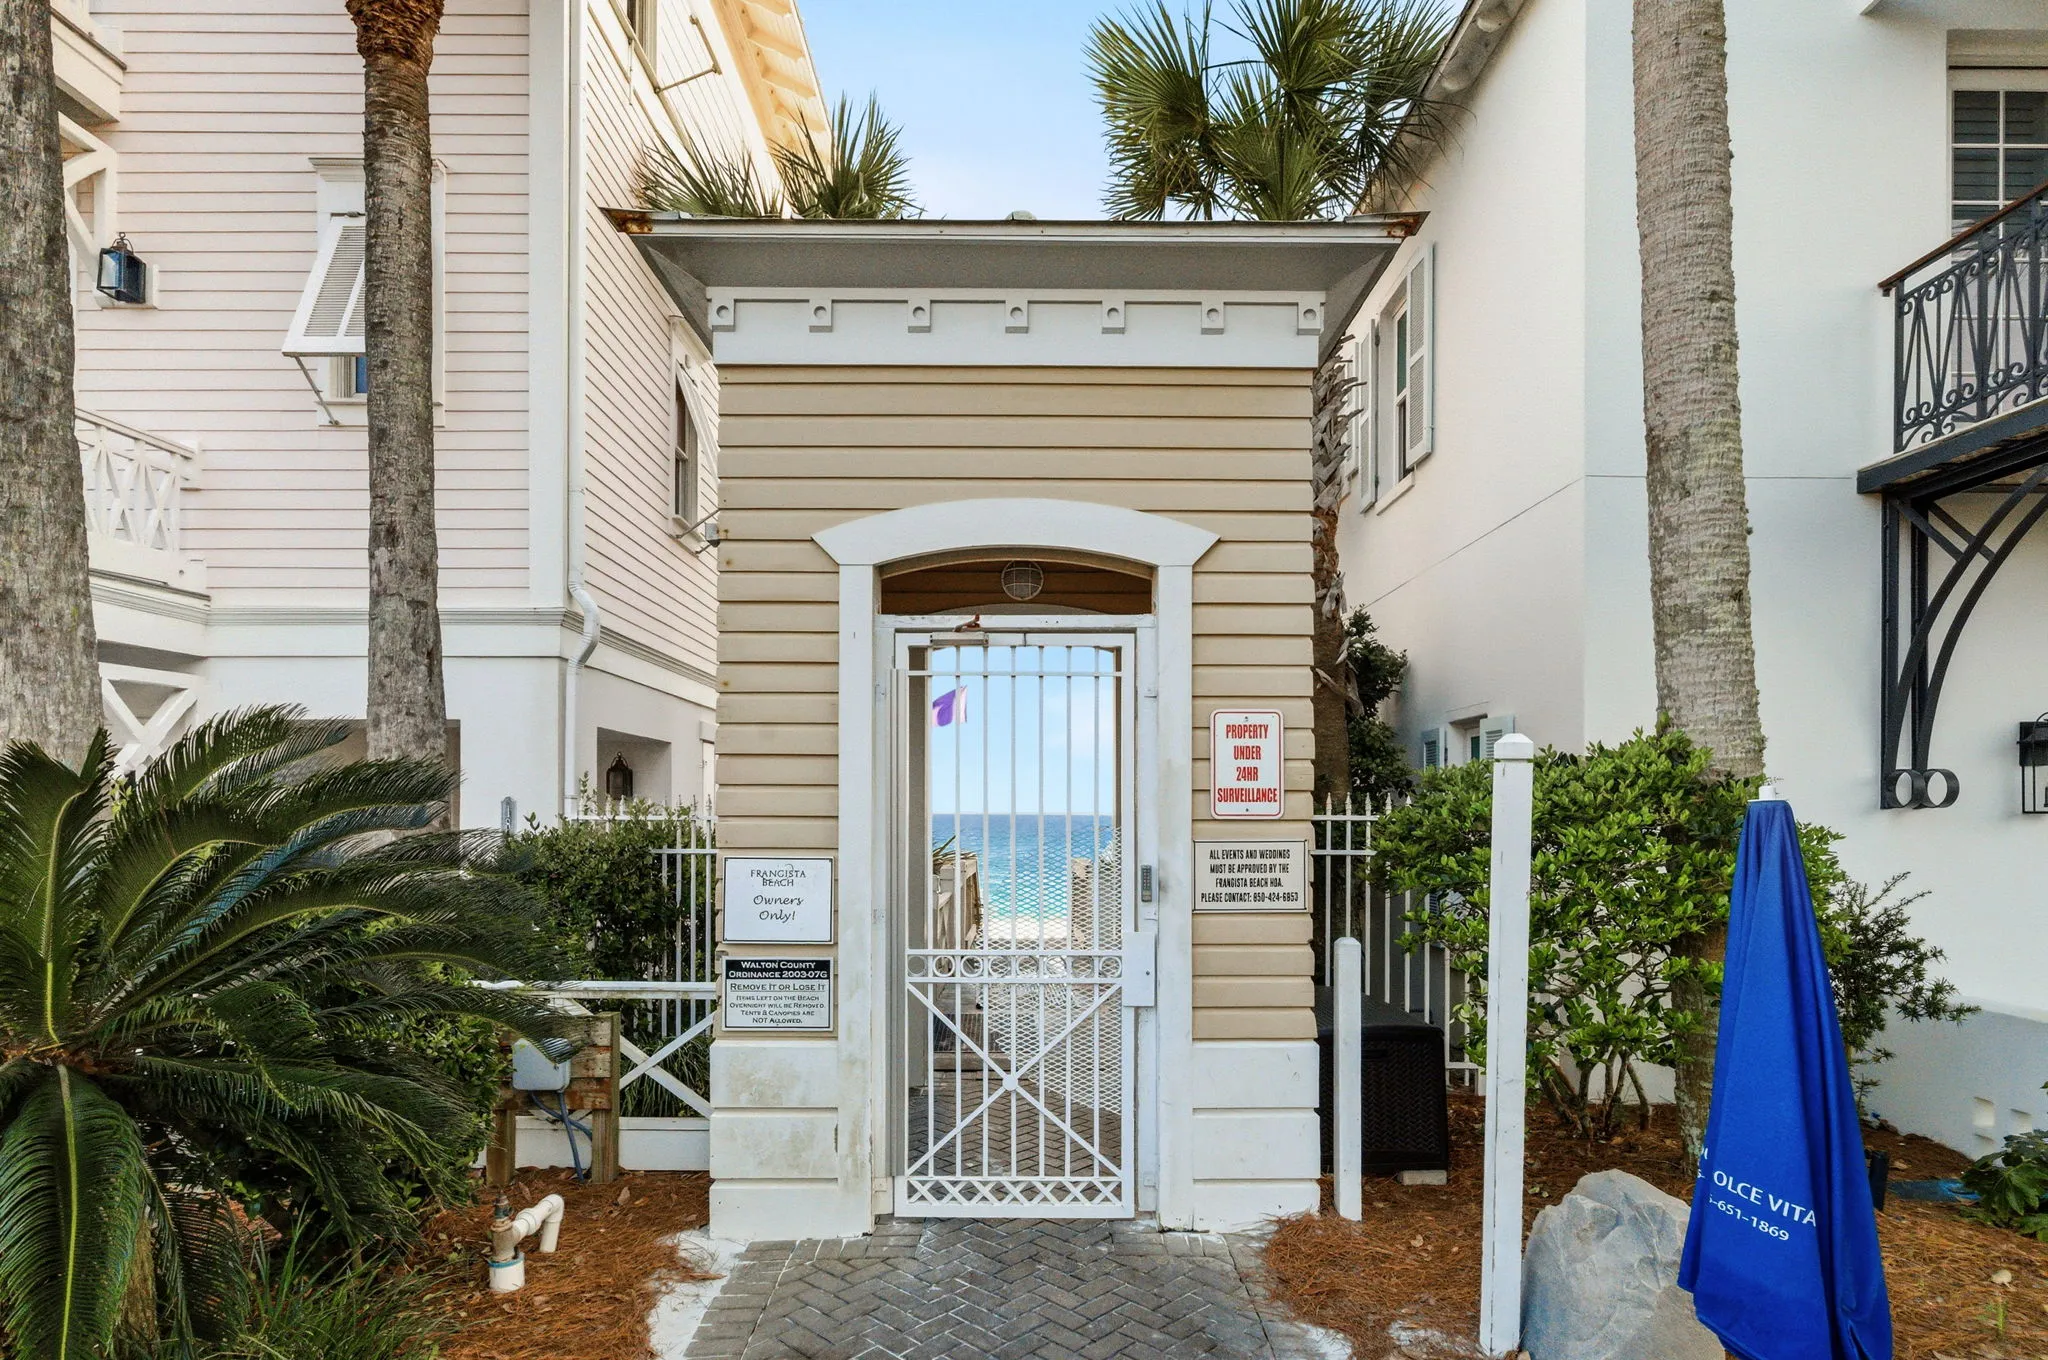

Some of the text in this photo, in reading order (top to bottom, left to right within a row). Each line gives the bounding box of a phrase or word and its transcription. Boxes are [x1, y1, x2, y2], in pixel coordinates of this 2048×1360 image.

[1226, 724, 1269, 739] PROPERTY
[1233, 745, 1262, 760] UNDER
[1236, 766, 1259, 781] 24HR
[1217, 787, 1278, 803] SURVEILLANCE
[1209, 849, 1291, 860] ALL EVENTS AND WEDDINGS
[750, 869, 807, 878] FRANGISTA
[1210, 863, 1290, 874] MUST BE APPROVED BY THE
[762, 878, 794, 887] BEACH
[1215, 878, 1248, 888] FRANGISTA
[1249, 878, 1269, 888] BEACH
[753, 894, 804, 906] Owners
[1200, 892, 1223, 903] PLEASE
[1224, 892, 1252, 903] CONTACT:
[759, 909, 796, 924] Only!
[740, 961, 816, 969] WALTON COUNTY
[728, 970, 781, 978] ORDINANCE
[730, 983, 767, 991] REMOVE
[778, 983, 791, 991] OR
[793, 983, 816, 991] LOSE
[1713, 1170, 1817, 1228] OLCE VITA
